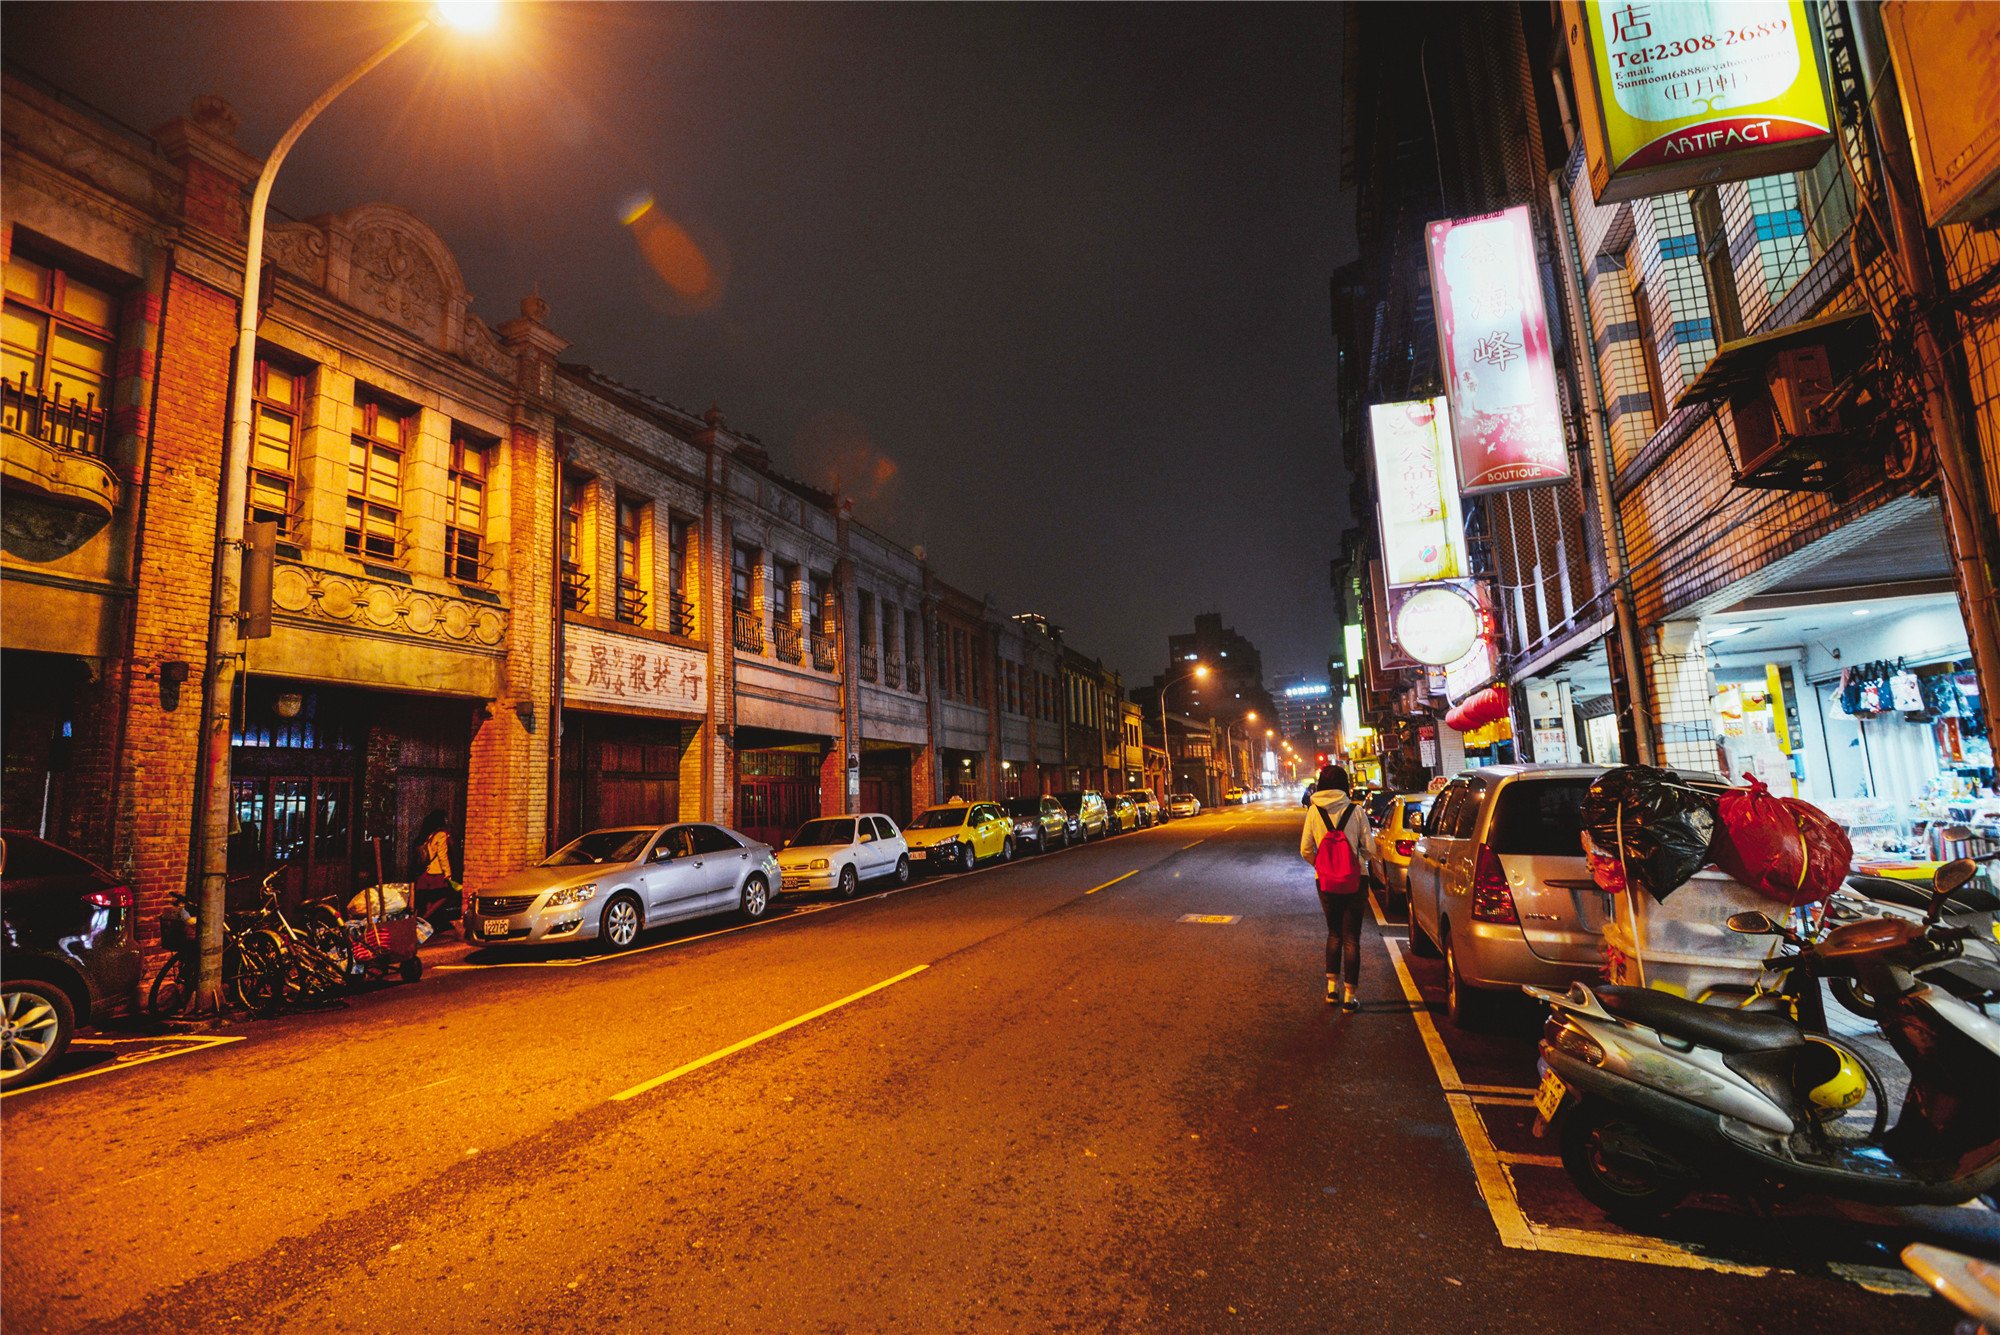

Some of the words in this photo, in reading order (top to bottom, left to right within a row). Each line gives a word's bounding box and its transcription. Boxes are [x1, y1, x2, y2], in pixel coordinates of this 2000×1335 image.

[1612, 4, 1652, 45] 店
[1664, 121, 1771, 156] ARTIFACT
[1487, 467, 1542, 482] BOUTIQUE
